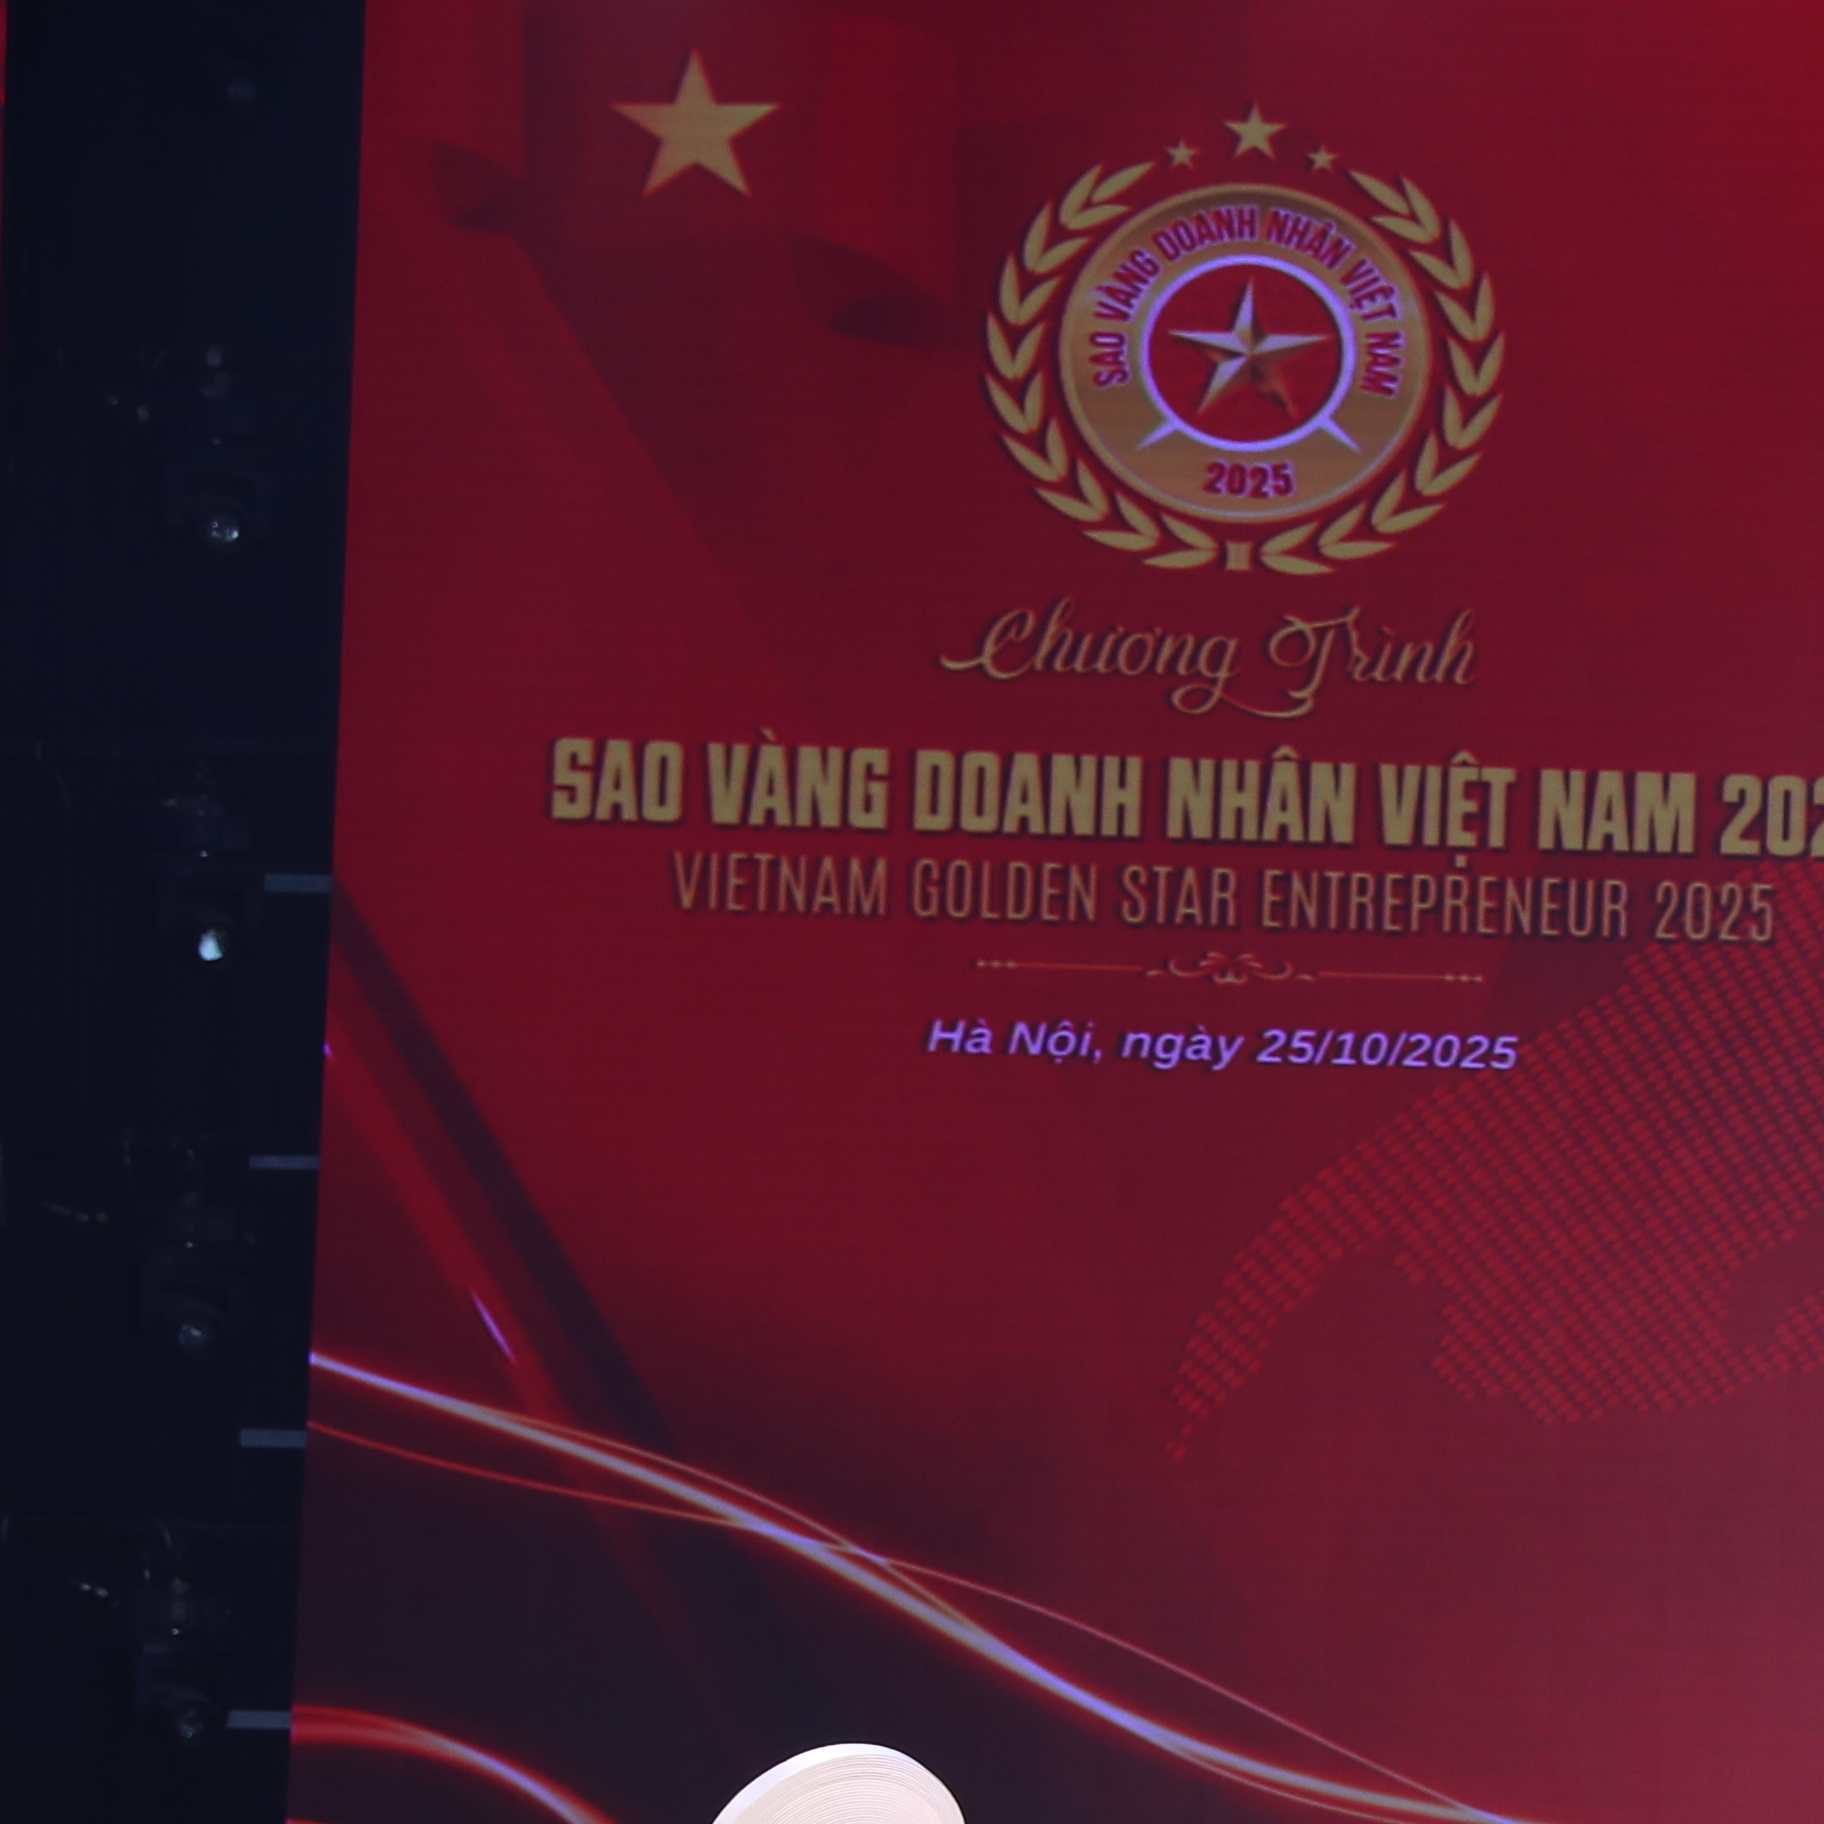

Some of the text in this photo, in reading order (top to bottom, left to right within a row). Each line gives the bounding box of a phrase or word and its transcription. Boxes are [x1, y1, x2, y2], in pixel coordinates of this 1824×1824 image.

[1089, 206, 1405, 397] SAO VÀNG DOANH NHÂN VIỆT NAM
[1204, 462, 1293, 498] 2025
[940, 598, 1477, 716] Chương Trình
[552, 736, 683, 823] SAO
[708, 728, 889, 829] VÀNG
[913, 748, 1142, 837] DOANH
[1166, 746, 1355, 844] NHÂN
[1378, 750, 1516, 868] VIỆT
[1537, 769, 1696, 855] NAM
[671, 851, 1776, 941] VIETNAM GOLDEN STAR ENTREPRENEUR 2025
[927, 1018, 1519, 1071] Hà Nội, ngày 25/10/2025
